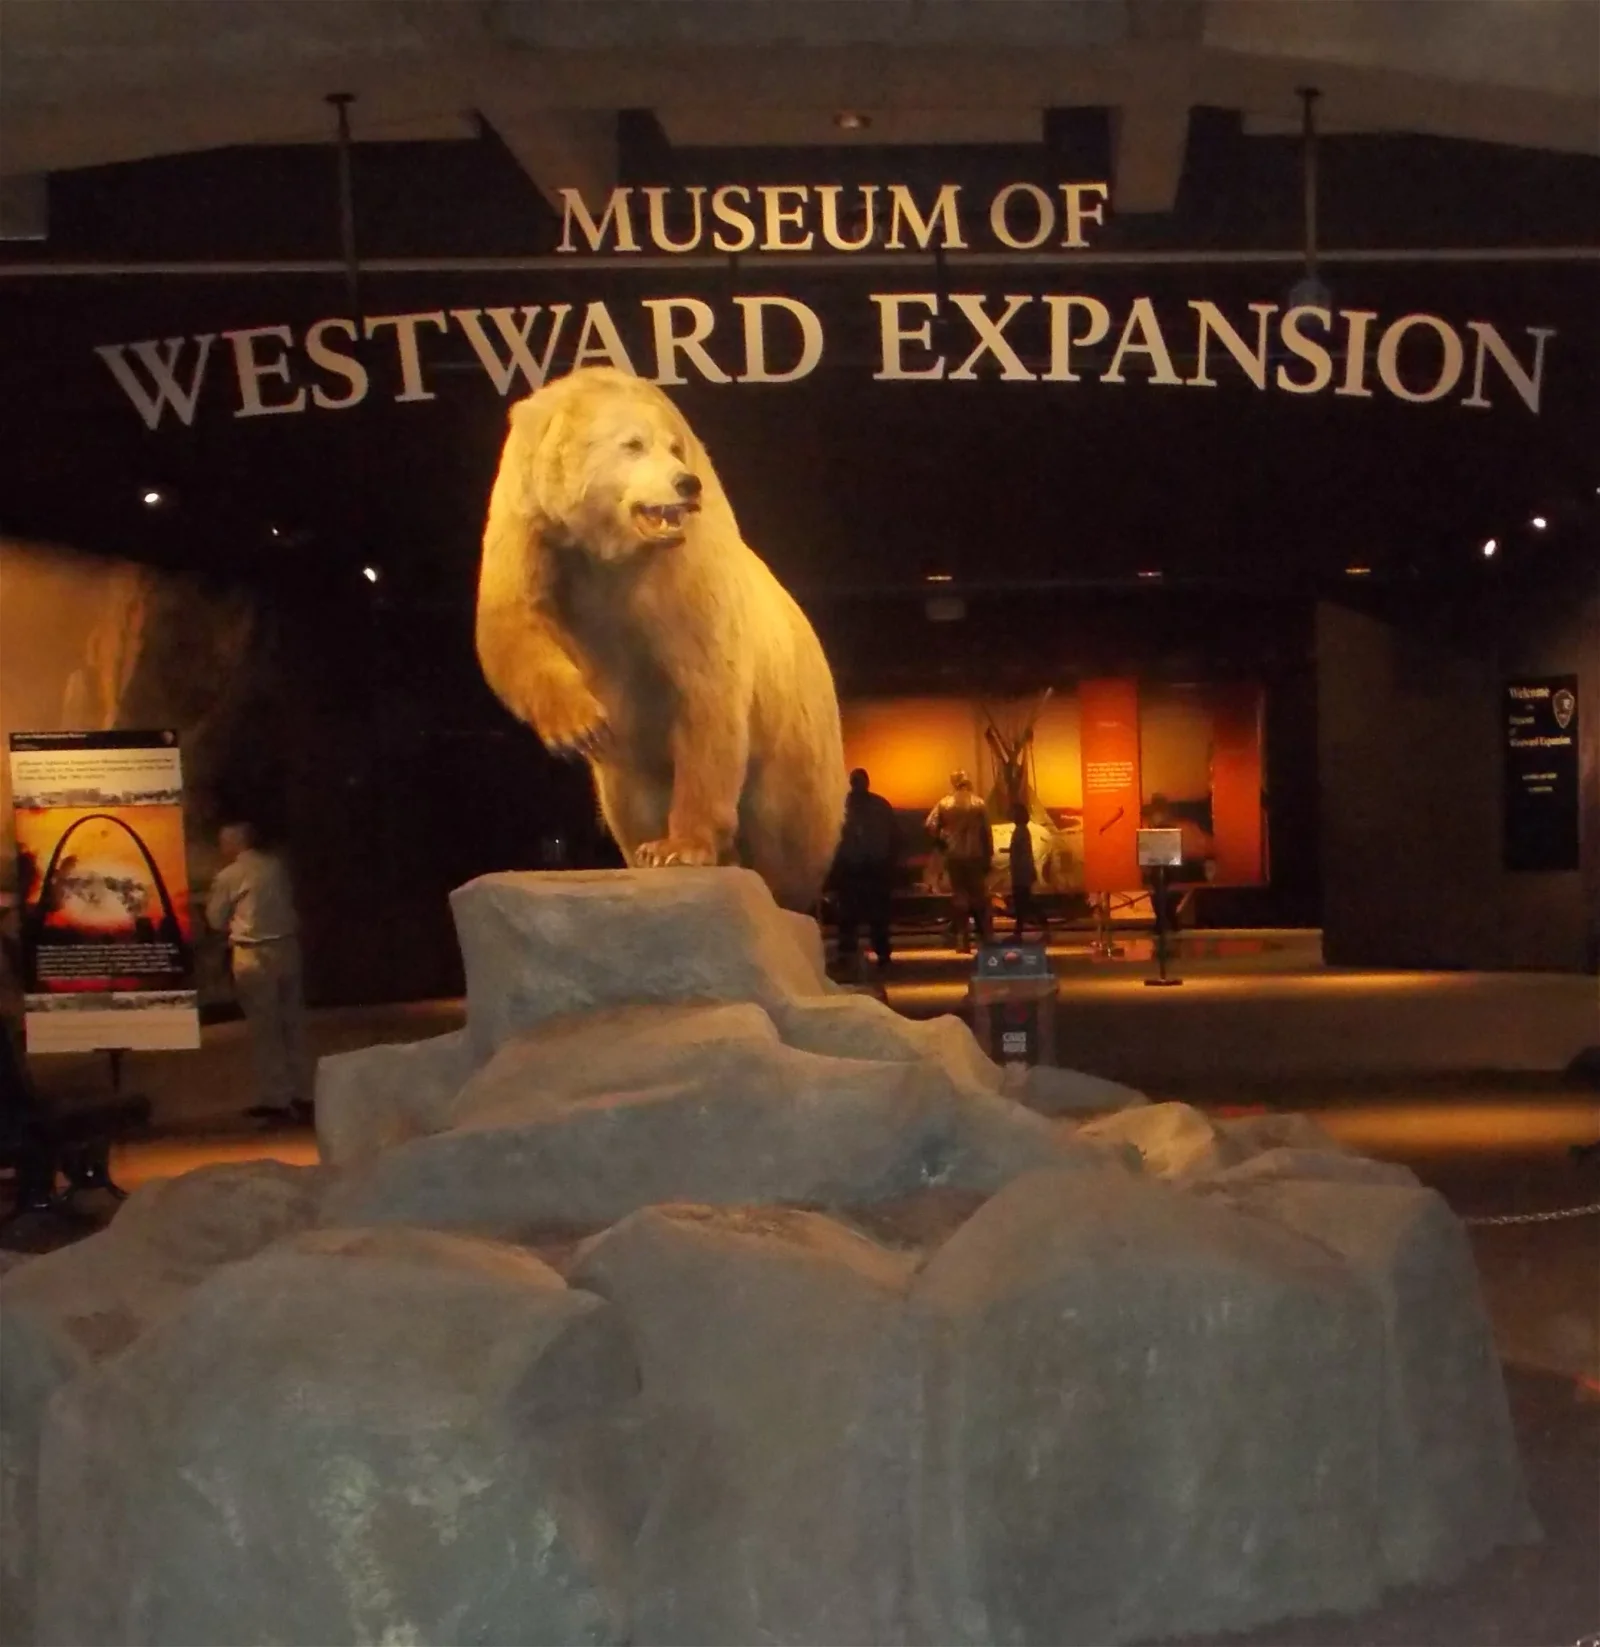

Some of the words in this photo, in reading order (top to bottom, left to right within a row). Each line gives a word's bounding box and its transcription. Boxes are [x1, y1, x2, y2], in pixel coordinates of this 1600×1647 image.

[555, 184, 969, 254] MUSEUM
[989, 182, 1109, 250] OF
[95, 295, 825, 431] WESTWARD
[869, 292, 1557, 415] EXPANSION
